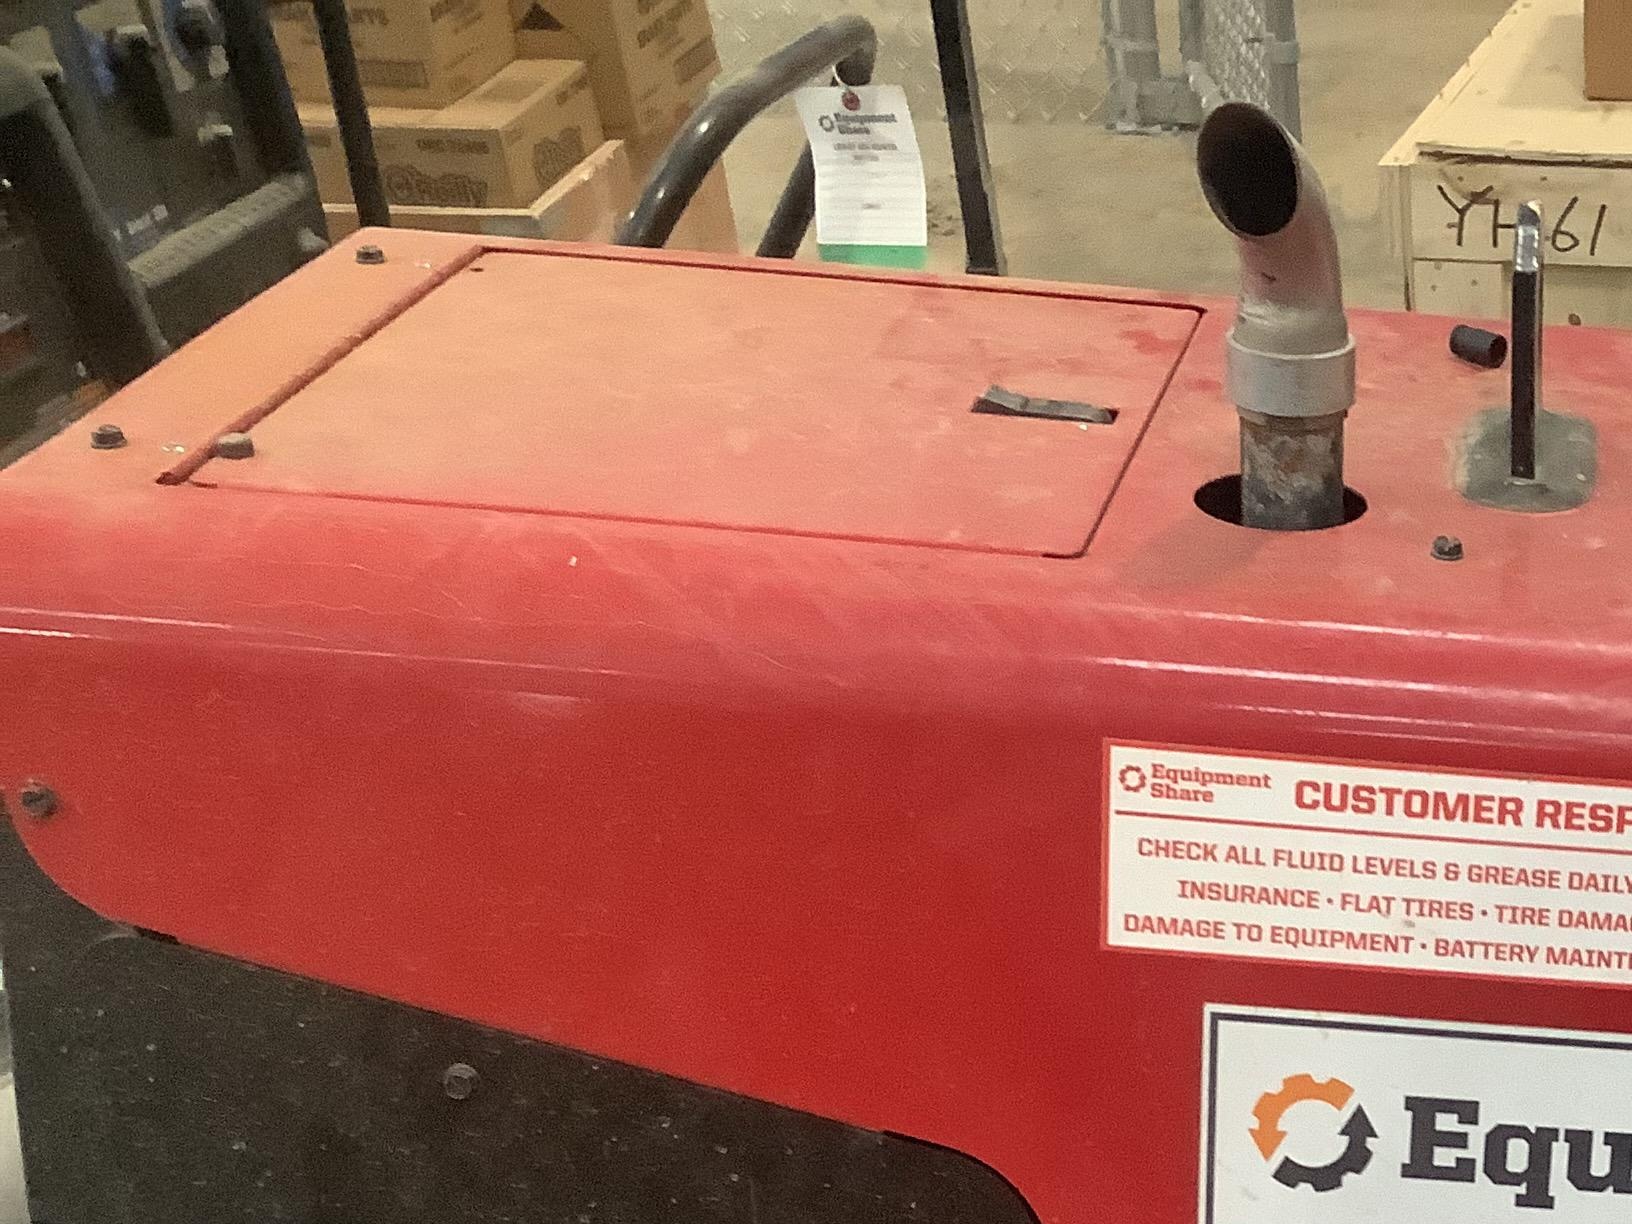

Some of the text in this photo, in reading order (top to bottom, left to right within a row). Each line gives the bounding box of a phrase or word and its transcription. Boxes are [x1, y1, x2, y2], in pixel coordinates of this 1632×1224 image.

[1150, 763, 1272, 790] Equipment
[1150, 785, 1214, 803] Share
[1294, 778, 1526, 828] CUSTOMER
[1137, 837, 1218, 863] CHECK
[1224, 845, 1267, 867] ALL
[1272, 848, 1344, 873] FLUID
[1351, 855, 1438, 881] LEVELS
[1444, 861, 1461, 882] &
[1466, 863, 1561, 890] GREASE
[1176, 879, 1320, 910] INSURANCE
[1340, 893, 1396, 917] FLAT
[1400, 898, 1474, 921] TIRES
[1494, 904, 1551, 927] TIRE
[1123, 913, 1226, 941] DAMAGE
[1232, 922, 1263, 942] TO
[1269, 925, 1415, 956] EQUIPMENT
[1433, 938, 1540, 965] BATTERY
